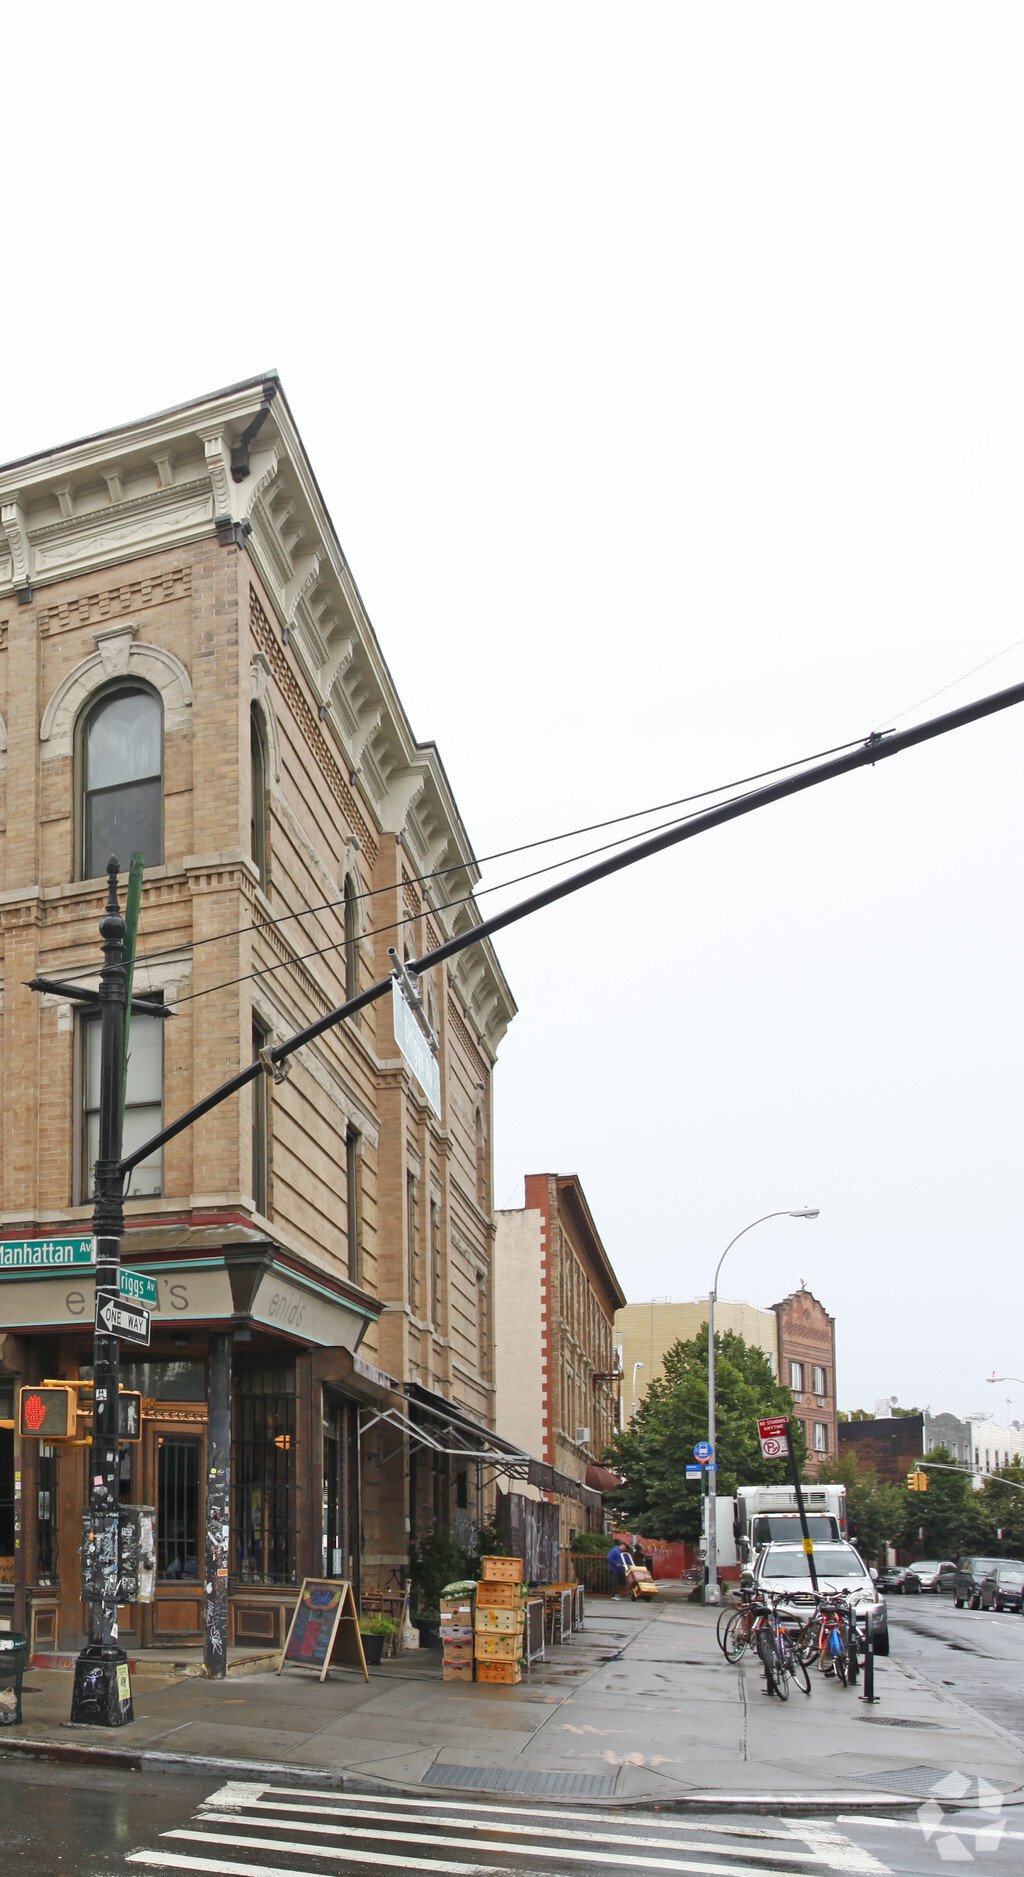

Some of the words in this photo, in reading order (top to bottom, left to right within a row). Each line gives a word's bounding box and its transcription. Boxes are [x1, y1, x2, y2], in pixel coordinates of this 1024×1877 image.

[79, 1241, 91, 1253] Av
[120, 1272, 144, 1297] riggs
[147, 1281, 155, 1292] Av
[105, 1307, 121, 1325] ONE
[128, 1315, 144, 1335] WAY
